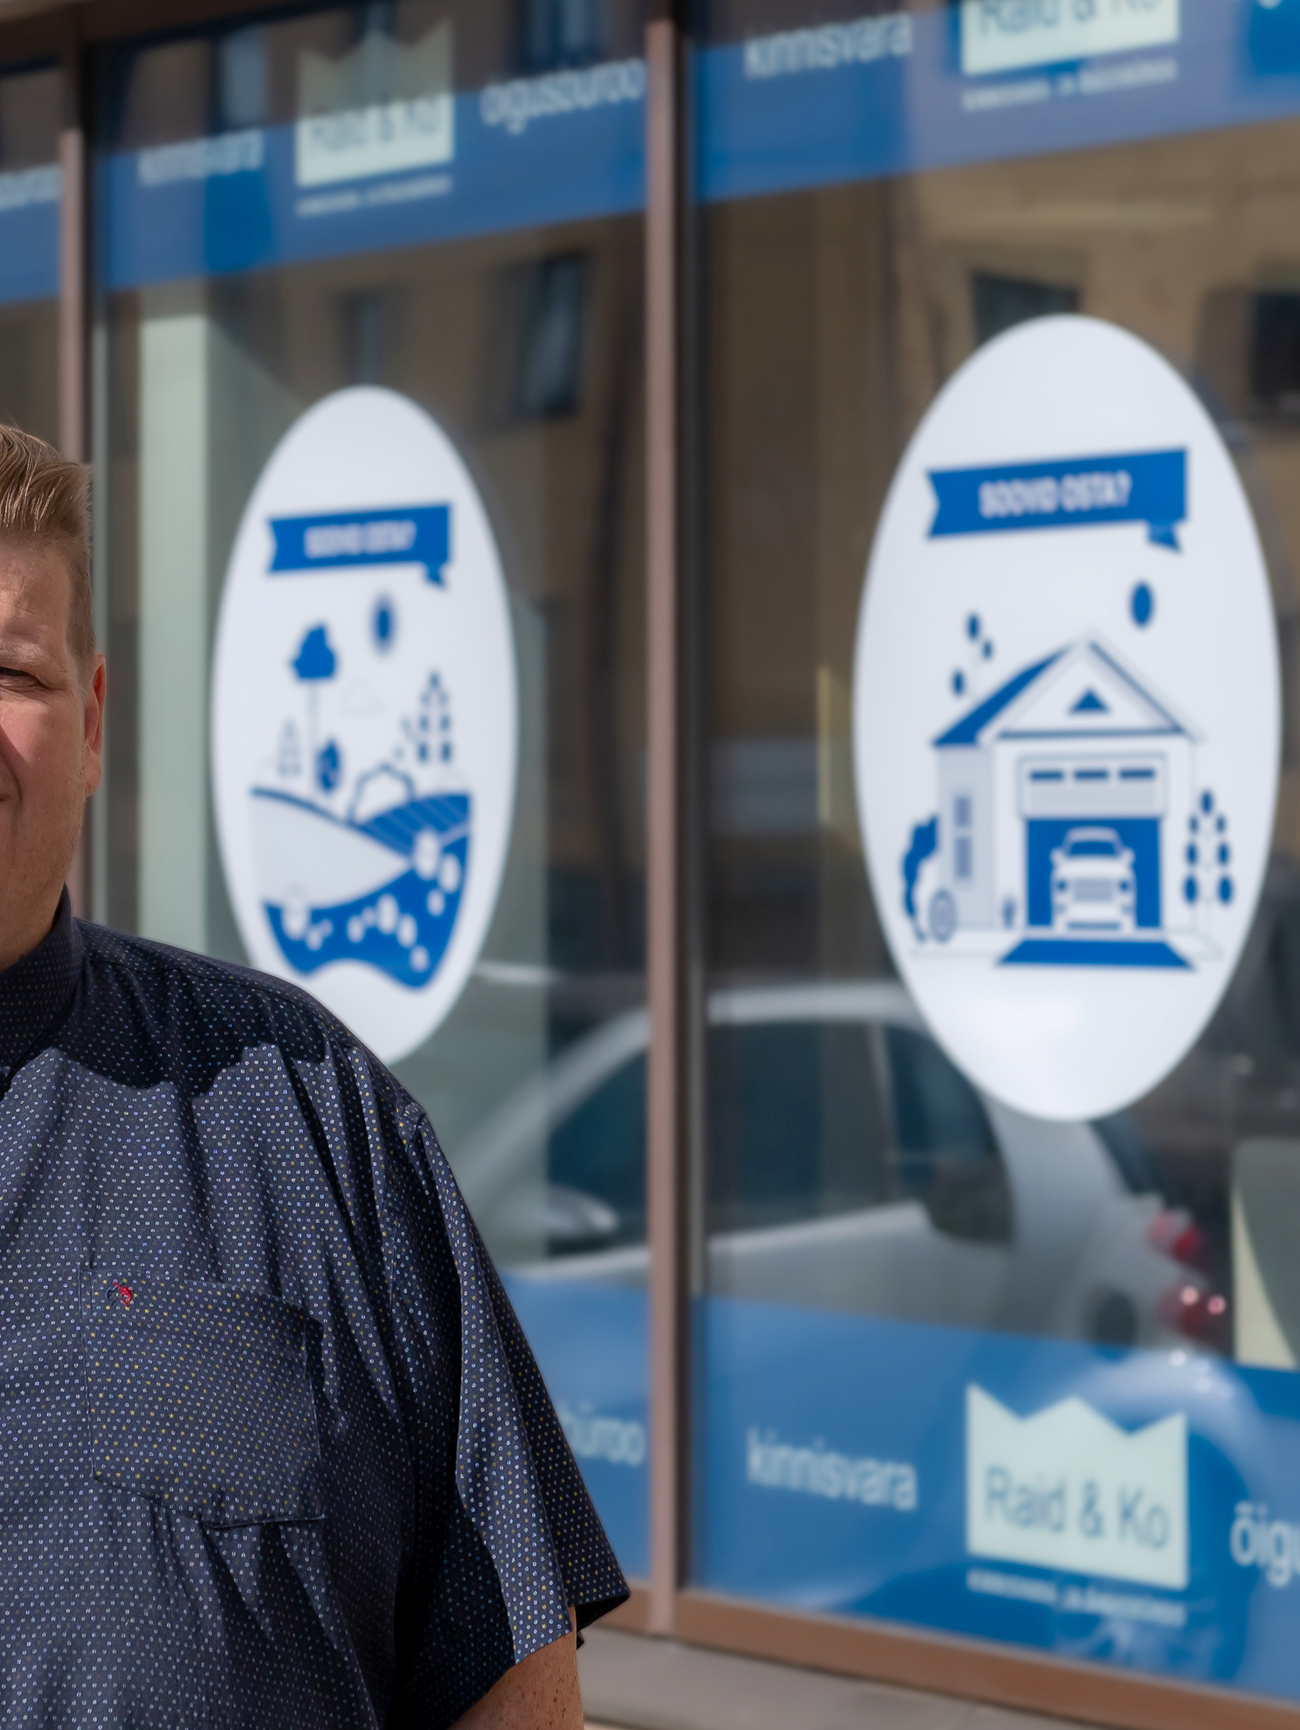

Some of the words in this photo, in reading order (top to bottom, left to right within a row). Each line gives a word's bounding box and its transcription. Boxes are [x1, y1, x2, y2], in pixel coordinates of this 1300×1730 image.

[747, 1428, 917, 1510] kinnisvara
[985, 1465, 1067, 1533] Raid
[1079, 1479, 1105, 1538] &
[1119, 1484, 1170, 1550] Ko
